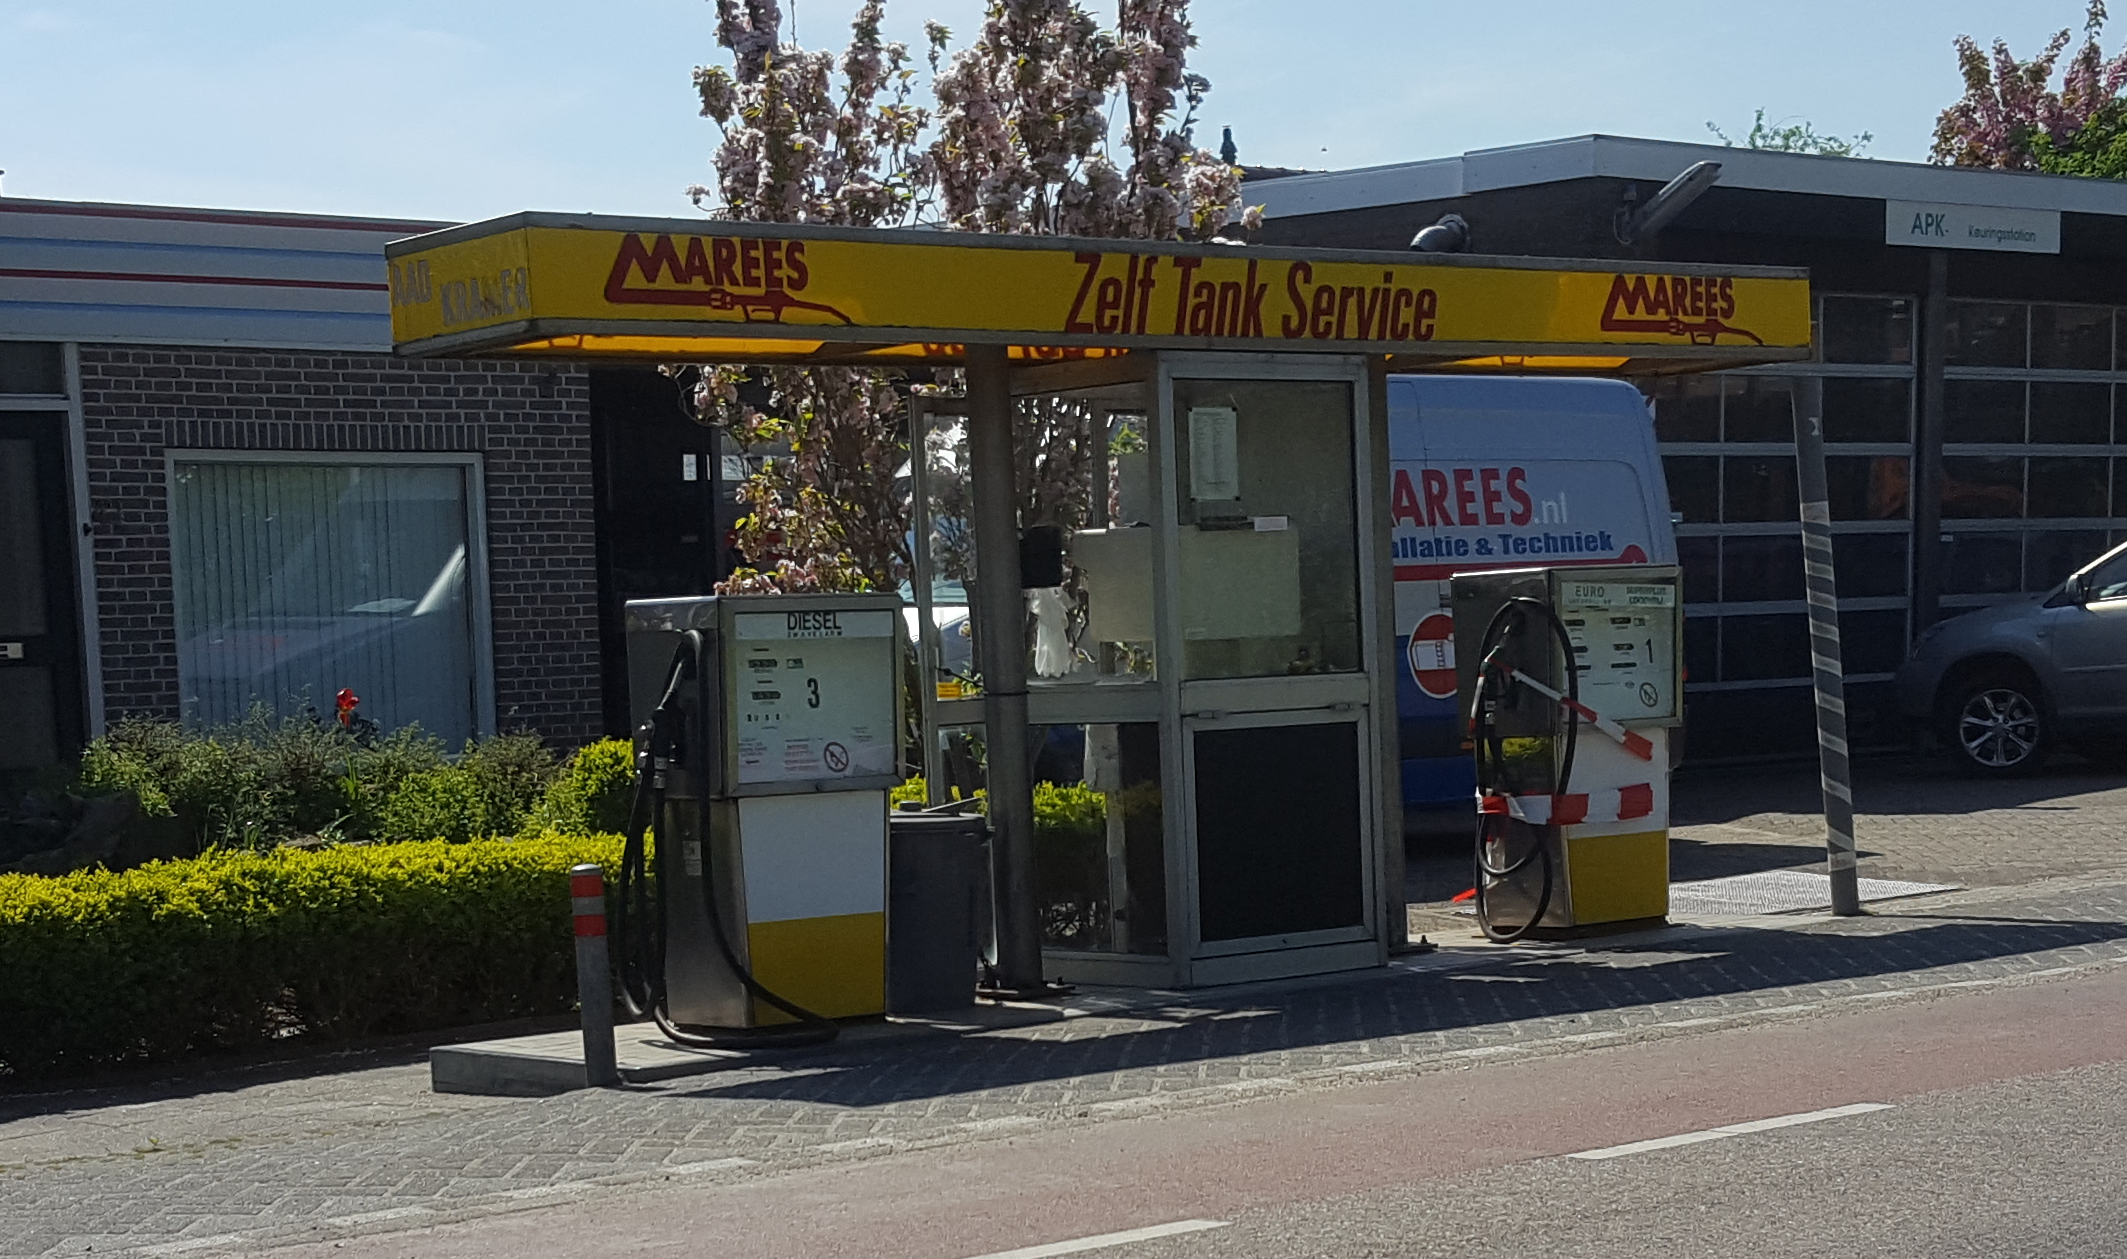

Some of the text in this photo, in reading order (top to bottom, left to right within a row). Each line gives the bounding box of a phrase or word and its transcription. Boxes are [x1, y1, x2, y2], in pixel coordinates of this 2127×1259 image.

[604, 233, 809, 297] MAREES
[1065, 253, 1438, 341] Zelf Tank Service
[1601, 274, 1735, 323] MAREES
[1391, 466, 1569, 527] AREES.nl
[1392, 531, 1615, 559] allatie & Techniek
[1574, 585, 1605, 598] EURO
[787, 611, 842, 630] DIESEL
[1645, 638, 1654, 664] 1
[806, 677, 820, 709] 3
